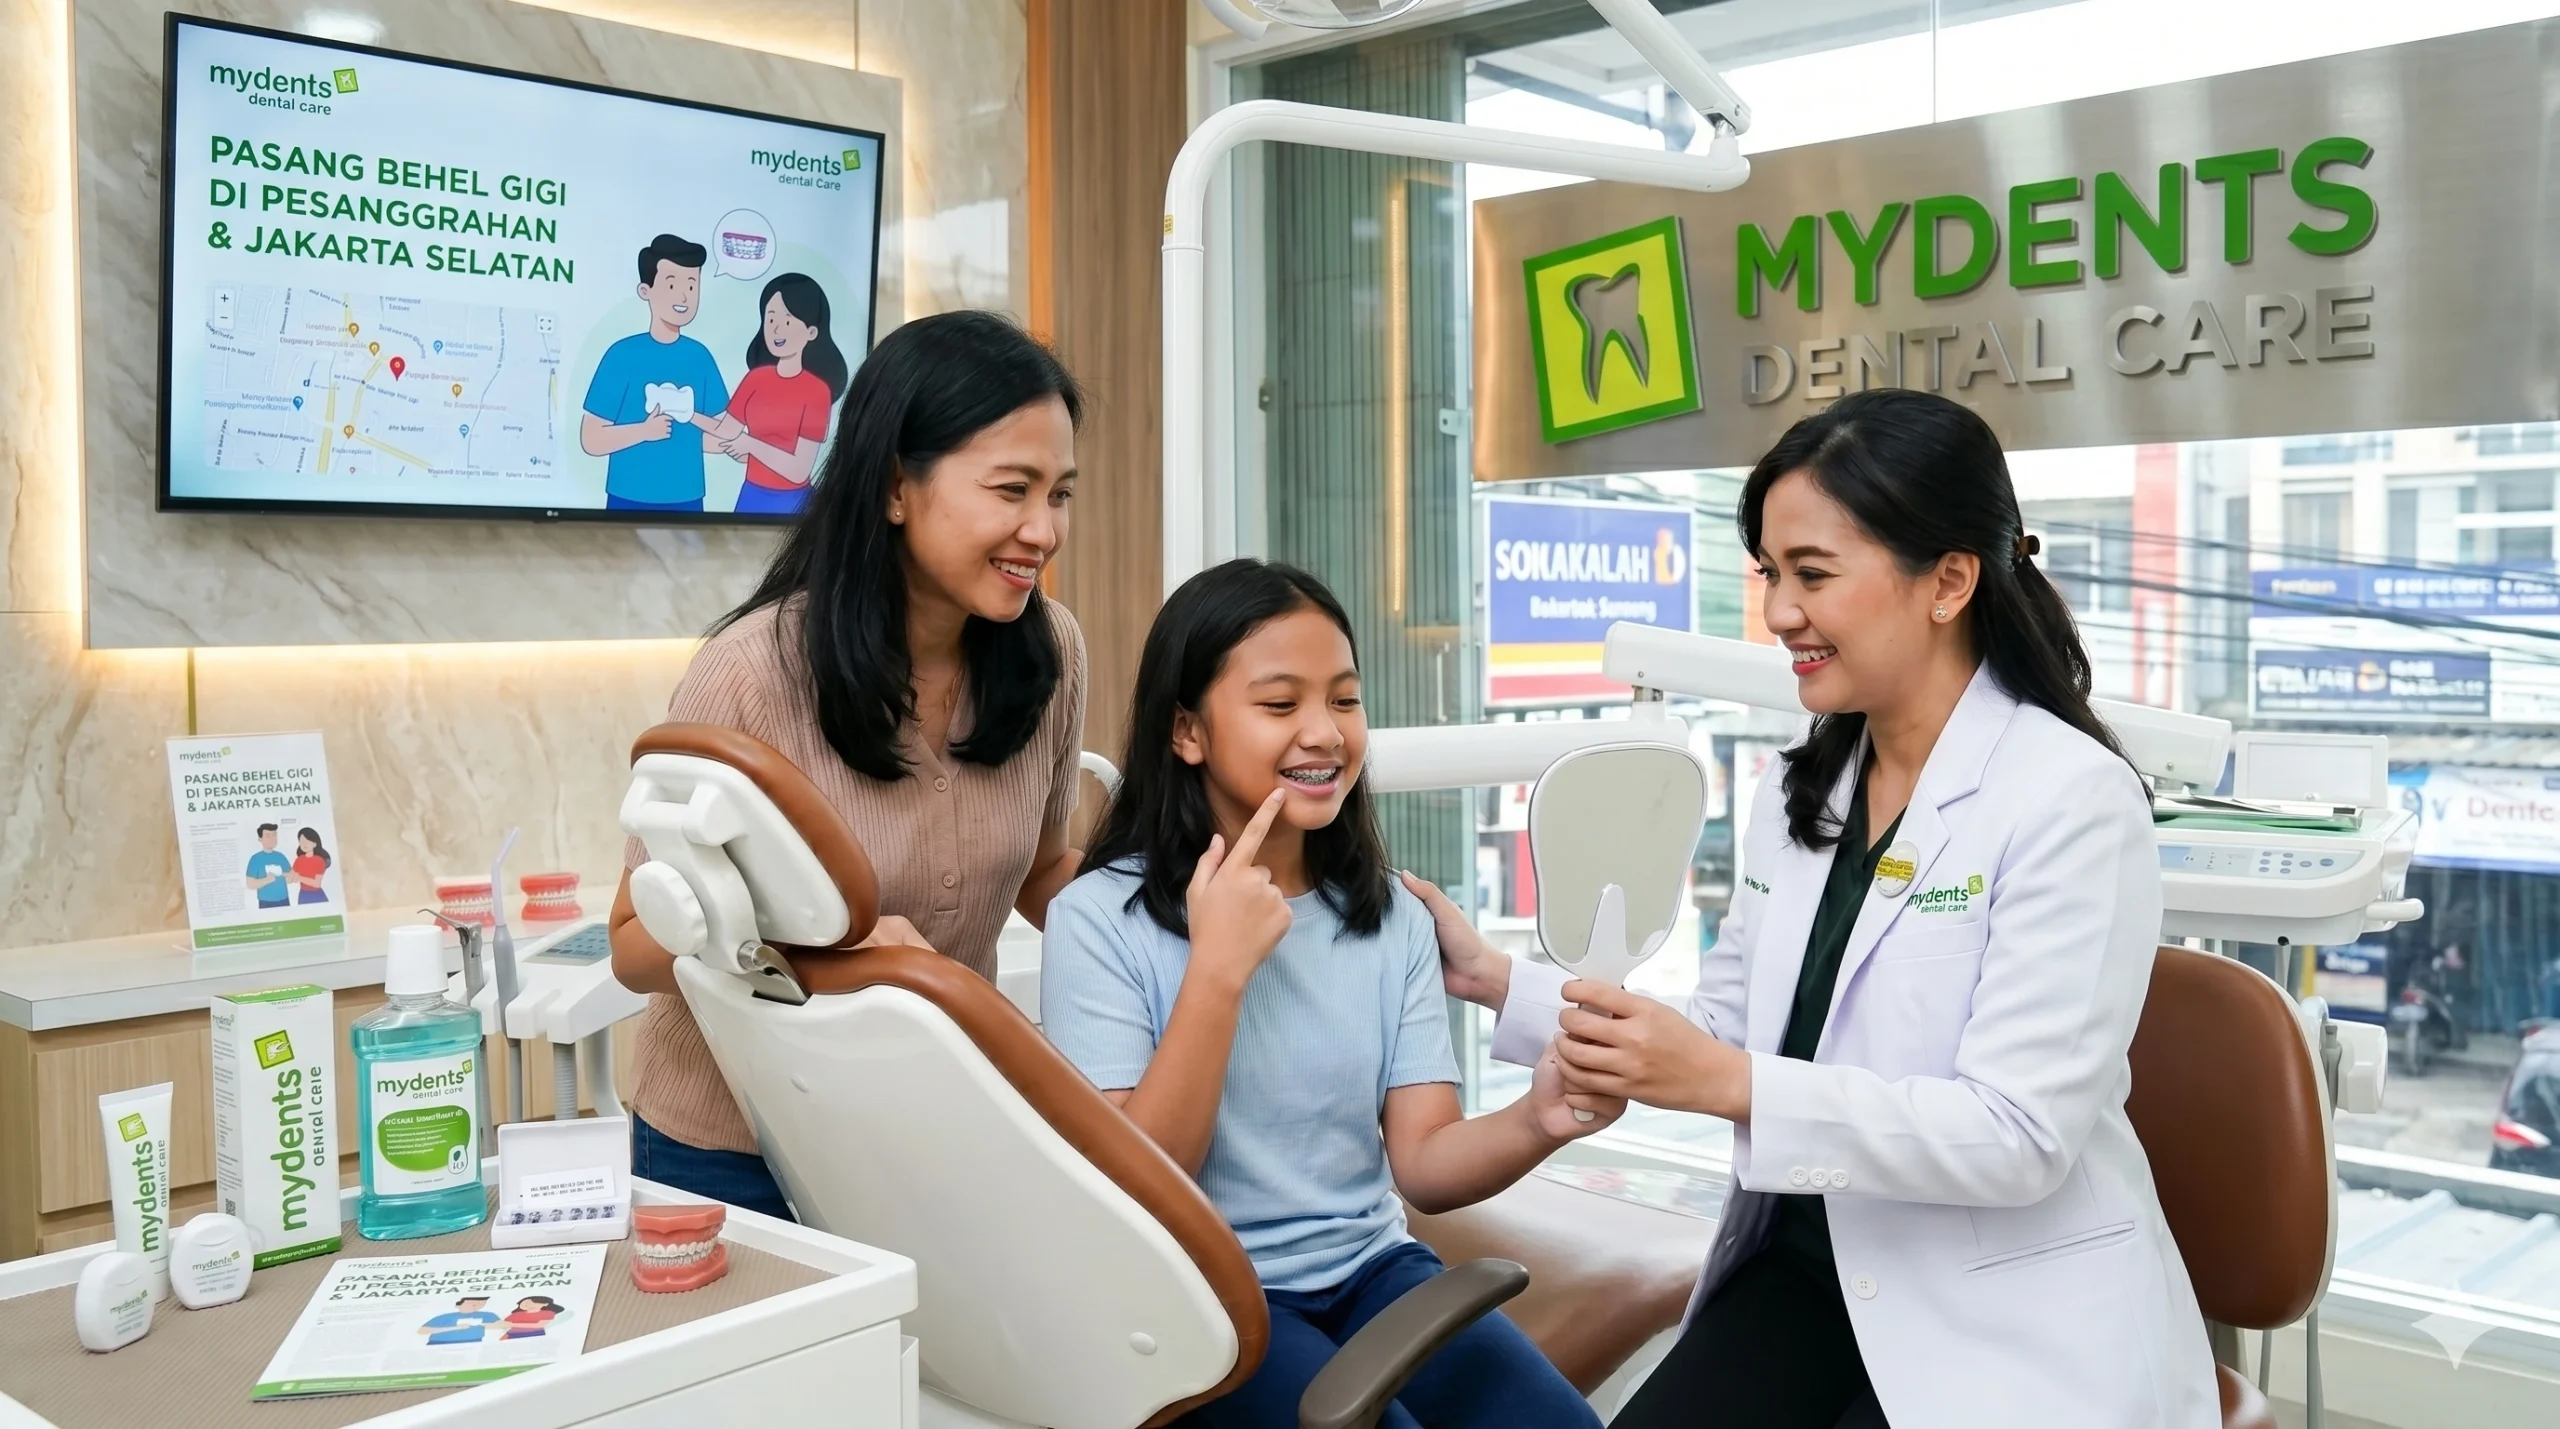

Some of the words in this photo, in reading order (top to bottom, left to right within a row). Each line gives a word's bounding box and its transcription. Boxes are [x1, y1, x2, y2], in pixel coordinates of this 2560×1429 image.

[210, 64, 332, 98] mydents
[249, 93, 295, 110] dental
[299, 101, 331, 115] care
[211, 135, 364, 182] PASANG
[377, 157, 489, 197] BEHEL
[500, 174, 566, 207] GIGI
[751, 149, 841, 176] mydents
[778, 173, 813, 187] dental
[210, 178, 247, 210] DI
[262, 184, 557, 244] PESANGGRAHAN
[1737, 137, 2376, 317] MYDENTS
[207, 221, 232, 250] &
[244, 225, 414, 268] JAKARTA
[425, 244, 574, 284] SELATAN
[1742, 317, 2071, 405] DENTAL
[2104, 284, 2376, 376] CARE
[179, 750, 222, 762] mydents
[185, 772, 238, 784] PASANG
[242, 770, 284, 782] BEHEL
[287, 768, 313, 779] GIGI
[186, 788, 200, 799] DI
[204, 782, 311, 798] PESANGGRAHAN
[187, 802, 197, 813] &
[201, 799, 260, 812] JAKARTA
[264, 794, 321, 807] SELATAN
[1907, 886, 1969, 909] mydents
[1948, 903, 1968, 912] care
[377, 1069, 465, 1097] mydents
[270, 1068, 316, 1231] mydents
[132, 1140, 163, 1252] mydents
[340, 1272, 436, 1283] PASANG
[526, 1263, 572, 1272] GIGI
[329, 1293, 344, 1301] &
[467, 1279, 572, 1293] SELATAN
[333, 1284, 358, 1292] DI
